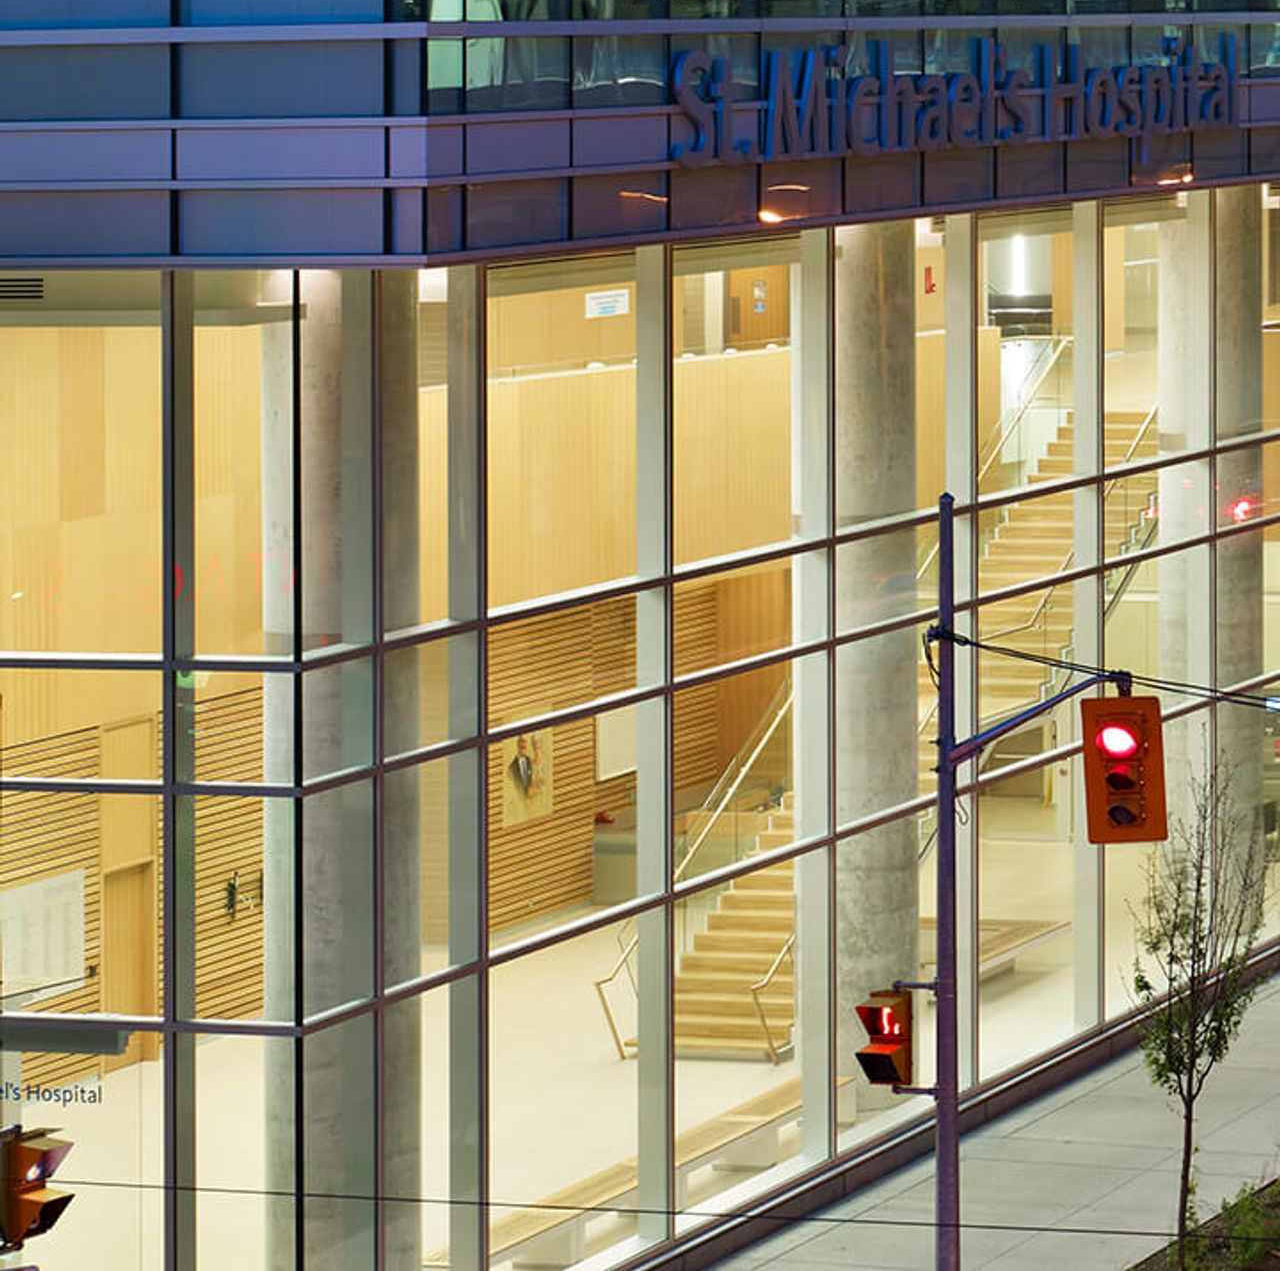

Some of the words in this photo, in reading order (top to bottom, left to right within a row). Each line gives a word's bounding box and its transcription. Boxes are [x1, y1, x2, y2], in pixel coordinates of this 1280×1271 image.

[763, 37, 1030, 162] Michael's
[1033, 31, 1236, 169] Hospital
[26, 1083, 102, 1107] Hospital
